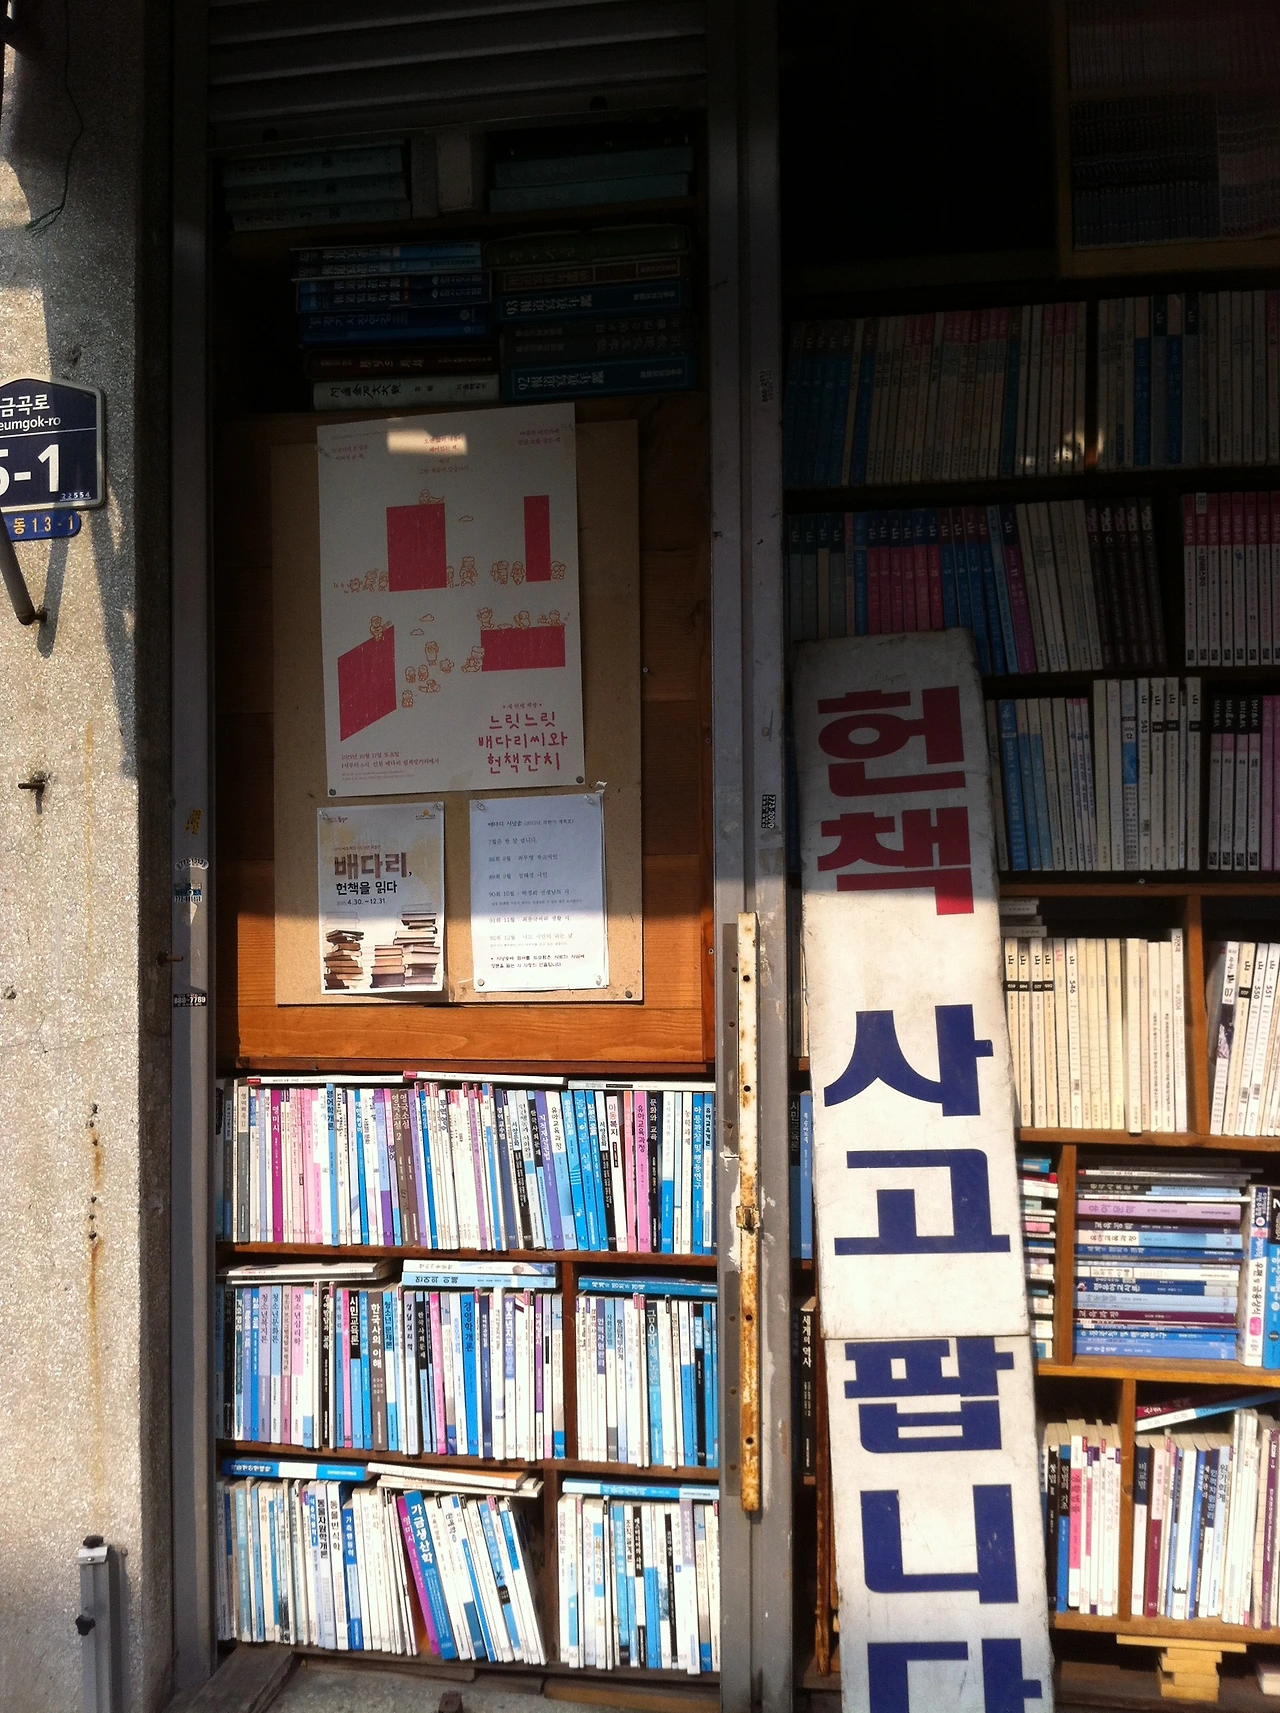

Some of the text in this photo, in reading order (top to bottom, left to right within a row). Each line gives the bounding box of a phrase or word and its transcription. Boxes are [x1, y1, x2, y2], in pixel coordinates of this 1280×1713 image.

[0, 394, 50, 417] 금곡로
[489, 711, 557, 730] 느릿느릿
[478, 732, 568, 749] 배다리씨와
[487, 752, 561, 775] 헌책잔치
[817, 686, 974, 915] 헌책
[336, 880, 398, 896] 헌책을 읽다
[1069, 979, 1077, 994] 546
[551, 1106, 562, 1151] 유아교육과정
[608, 1104, 618, 1136] 아동복지
[1251, 1285, 1263, 1315] 금융상식
[293, 1293, 301, 1346] 청소년심리학
[349, 1296, 360, 1346] 시민교육론
[370, 1303, 382, 1369] 한국사의 이해
[317, 1499, 328, 1559] 동물자원학개론
[410, 1504, 433, 1563] 가금생산학
